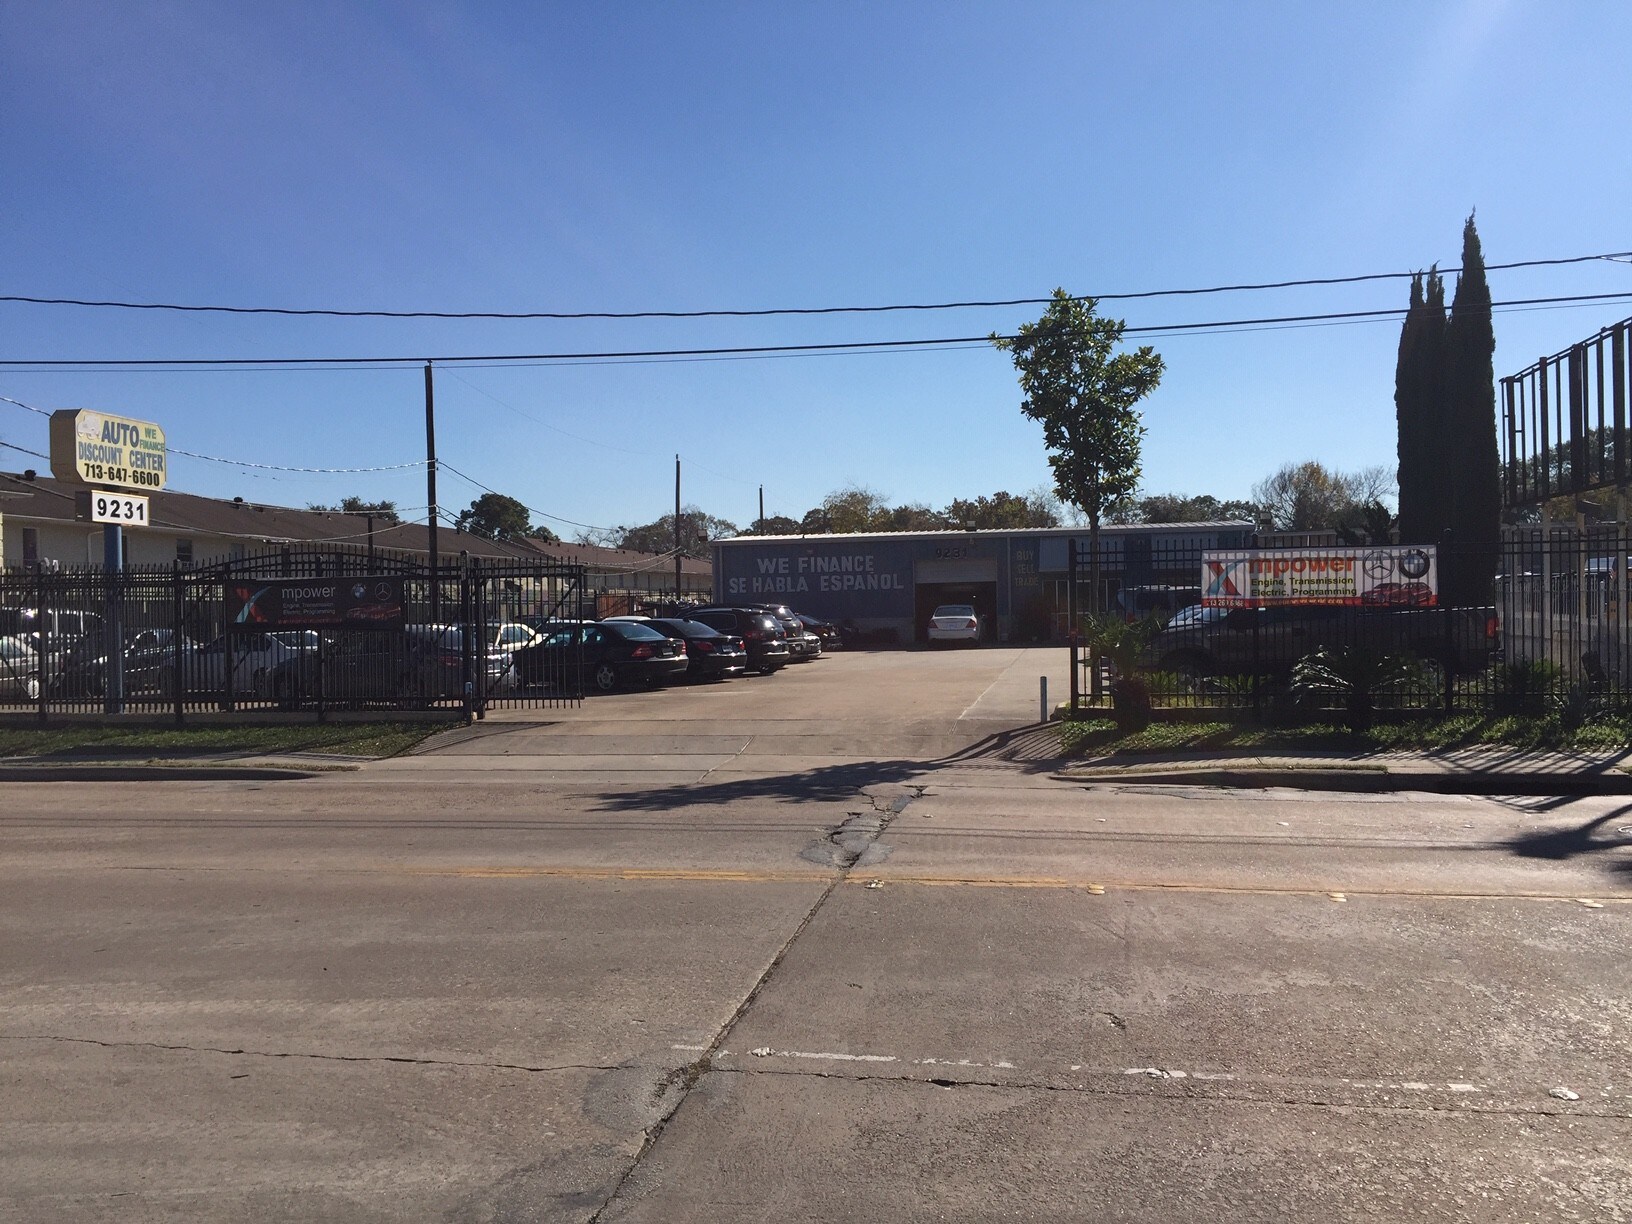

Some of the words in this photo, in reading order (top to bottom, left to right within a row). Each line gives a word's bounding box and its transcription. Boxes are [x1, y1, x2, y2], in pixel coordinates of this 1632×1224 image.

[101, 420, 140, 448] AUTO
[144, 427, 157, 439] WE
[139, 439, 165, 452] FINANCE
[78, 441, 123, 465] DISCOUNT
[129, 450, 164, 472] CENTER
[84, 463, 160, 486] 713-647-6600
[97, 498, 144, 520] 9231
[757, 558, 789, 574] WE
[799, 555, 874, 573] FINANCE
[1016, 550, 1034, 561] BUY
[1249, 556, 1358, 578] mpower
[729, 577, 747, 594] SE
[752, 577, 809, 593] HABLA
[820, 572, 905, 592] ESPAÑOL
[1289, 576, 1354, 586] Transmission
[281, 585, 336, 602] mpower
[1292, 587, 1358, 597] Programming
